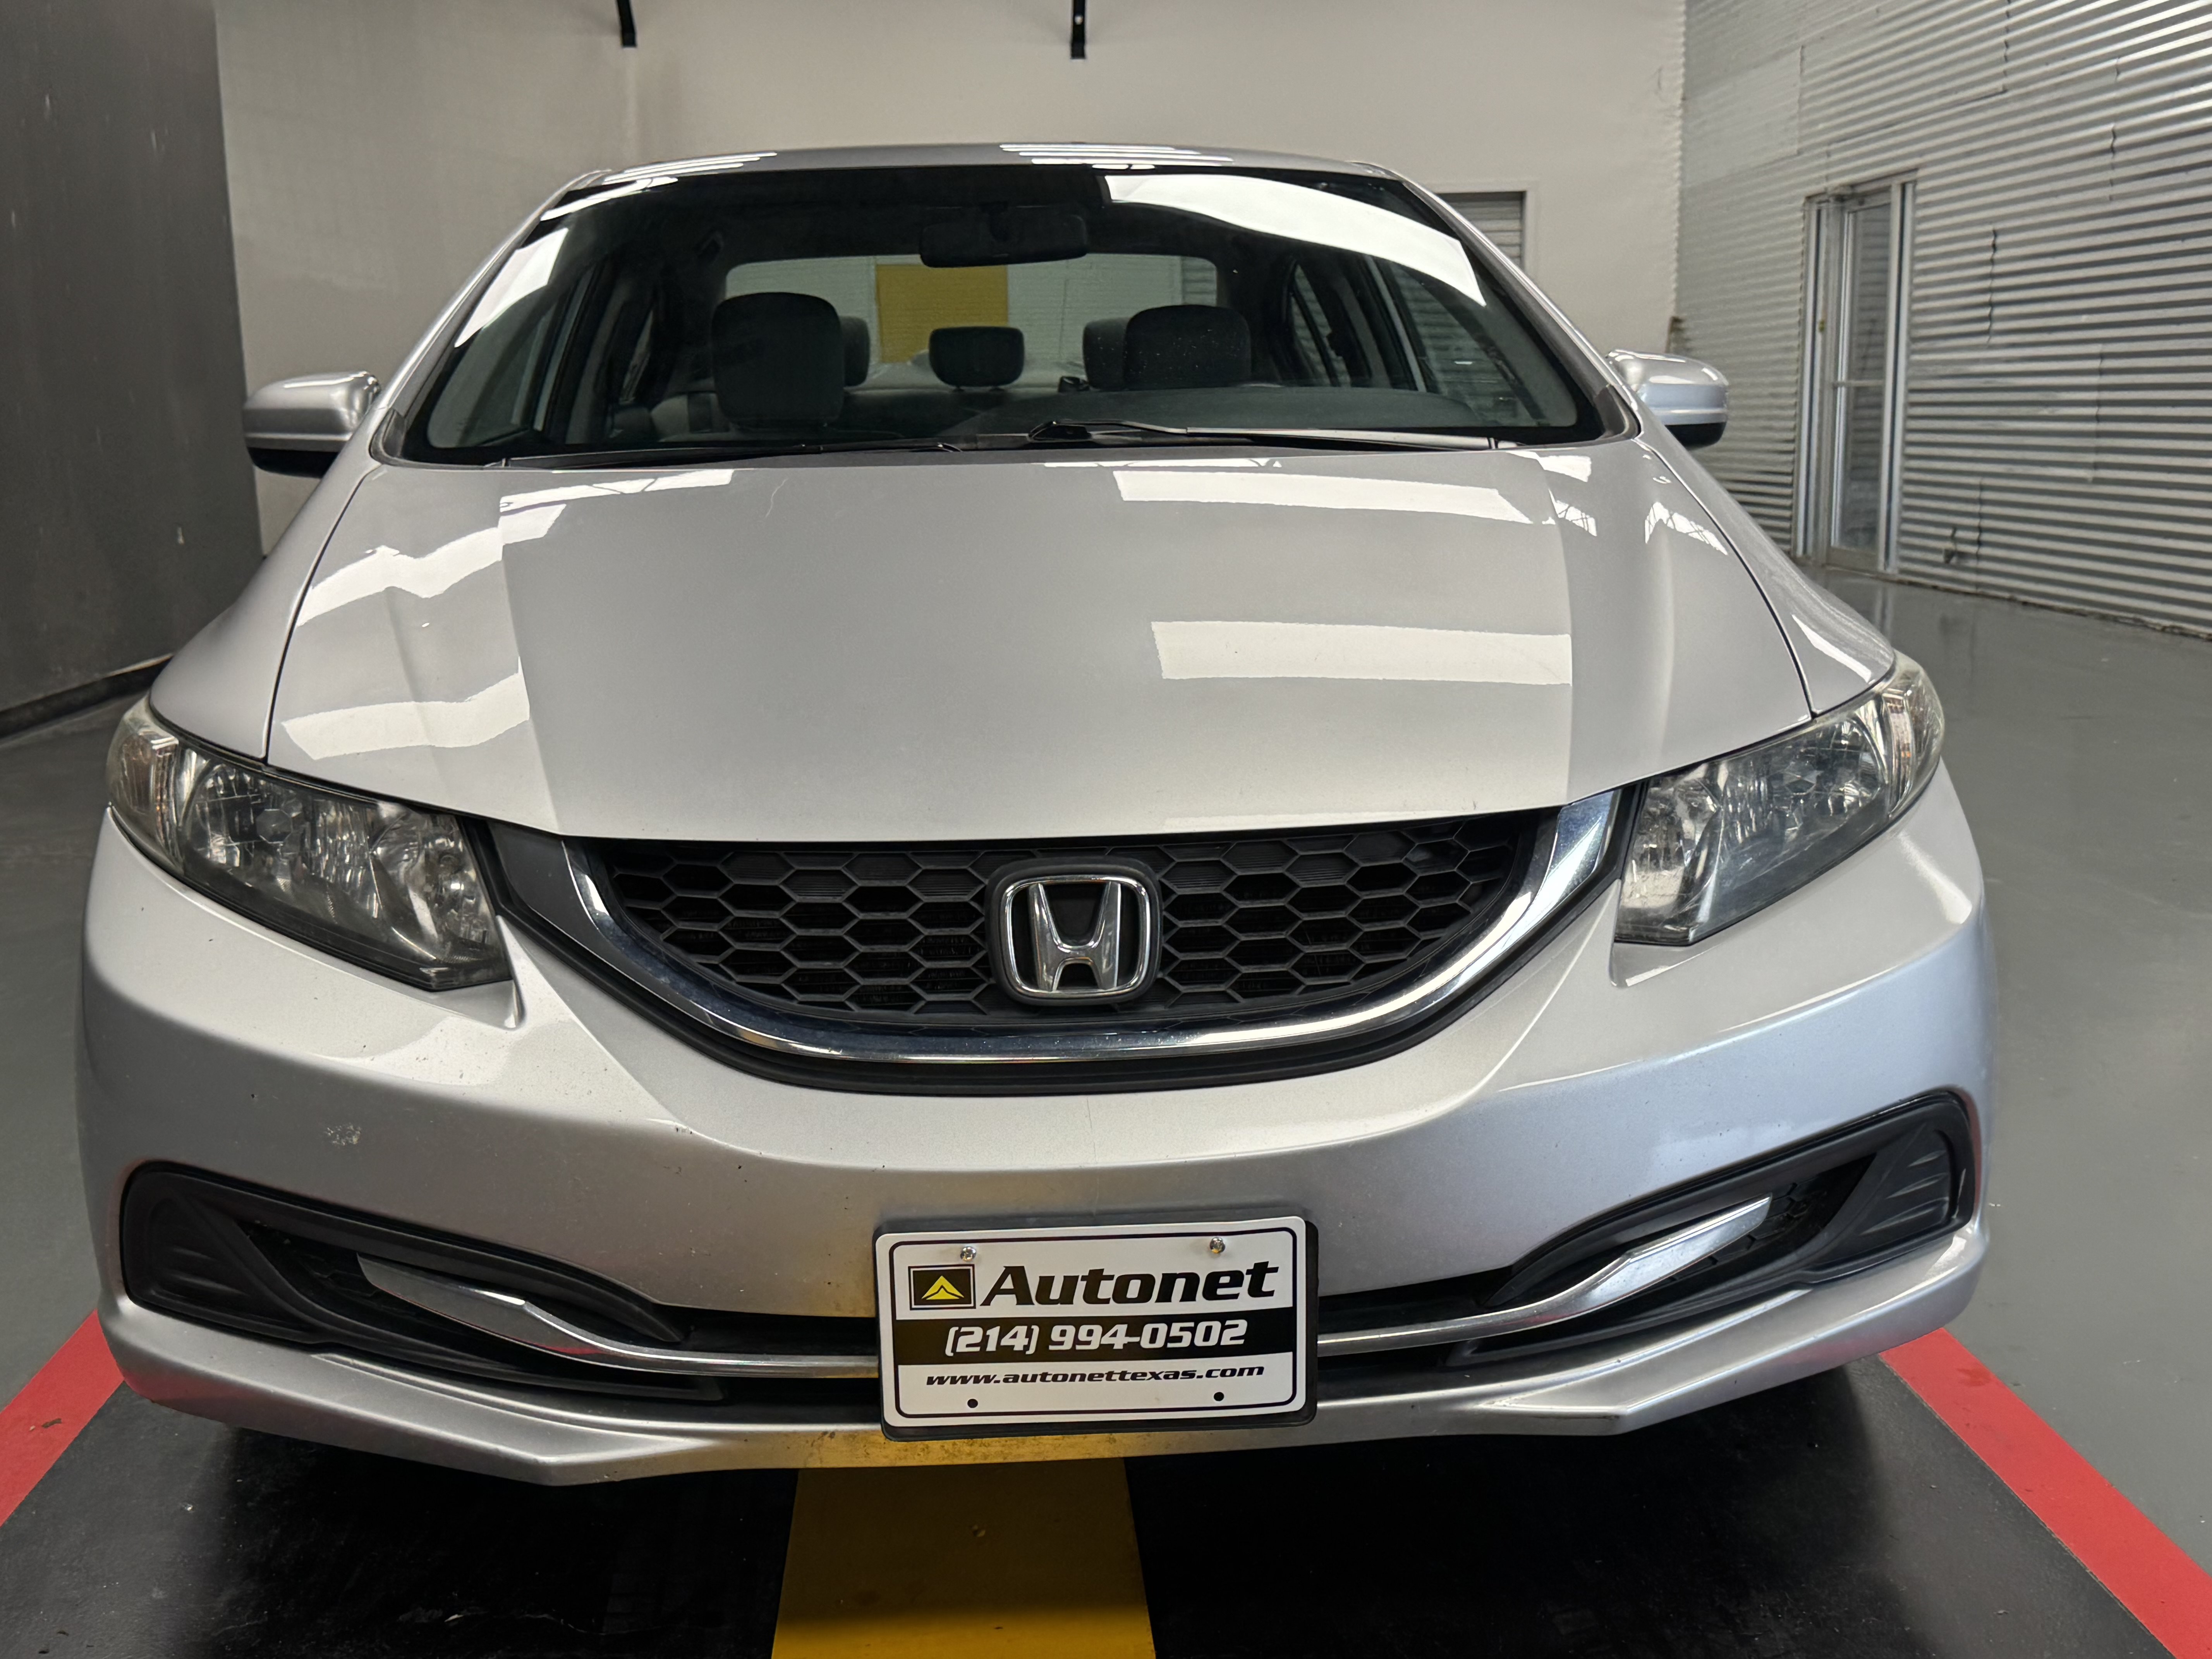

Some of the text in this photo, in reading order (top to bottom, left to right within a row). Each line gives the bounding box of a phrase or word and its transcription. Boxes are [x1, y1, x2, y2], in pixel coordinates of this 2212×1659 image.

[980, 1261, 1279, 1306] Autonet
[945, 1319, 1247, 1357] (214) 994-0502
[927, 1366, 1264, 1385] www.autonettexas.com
